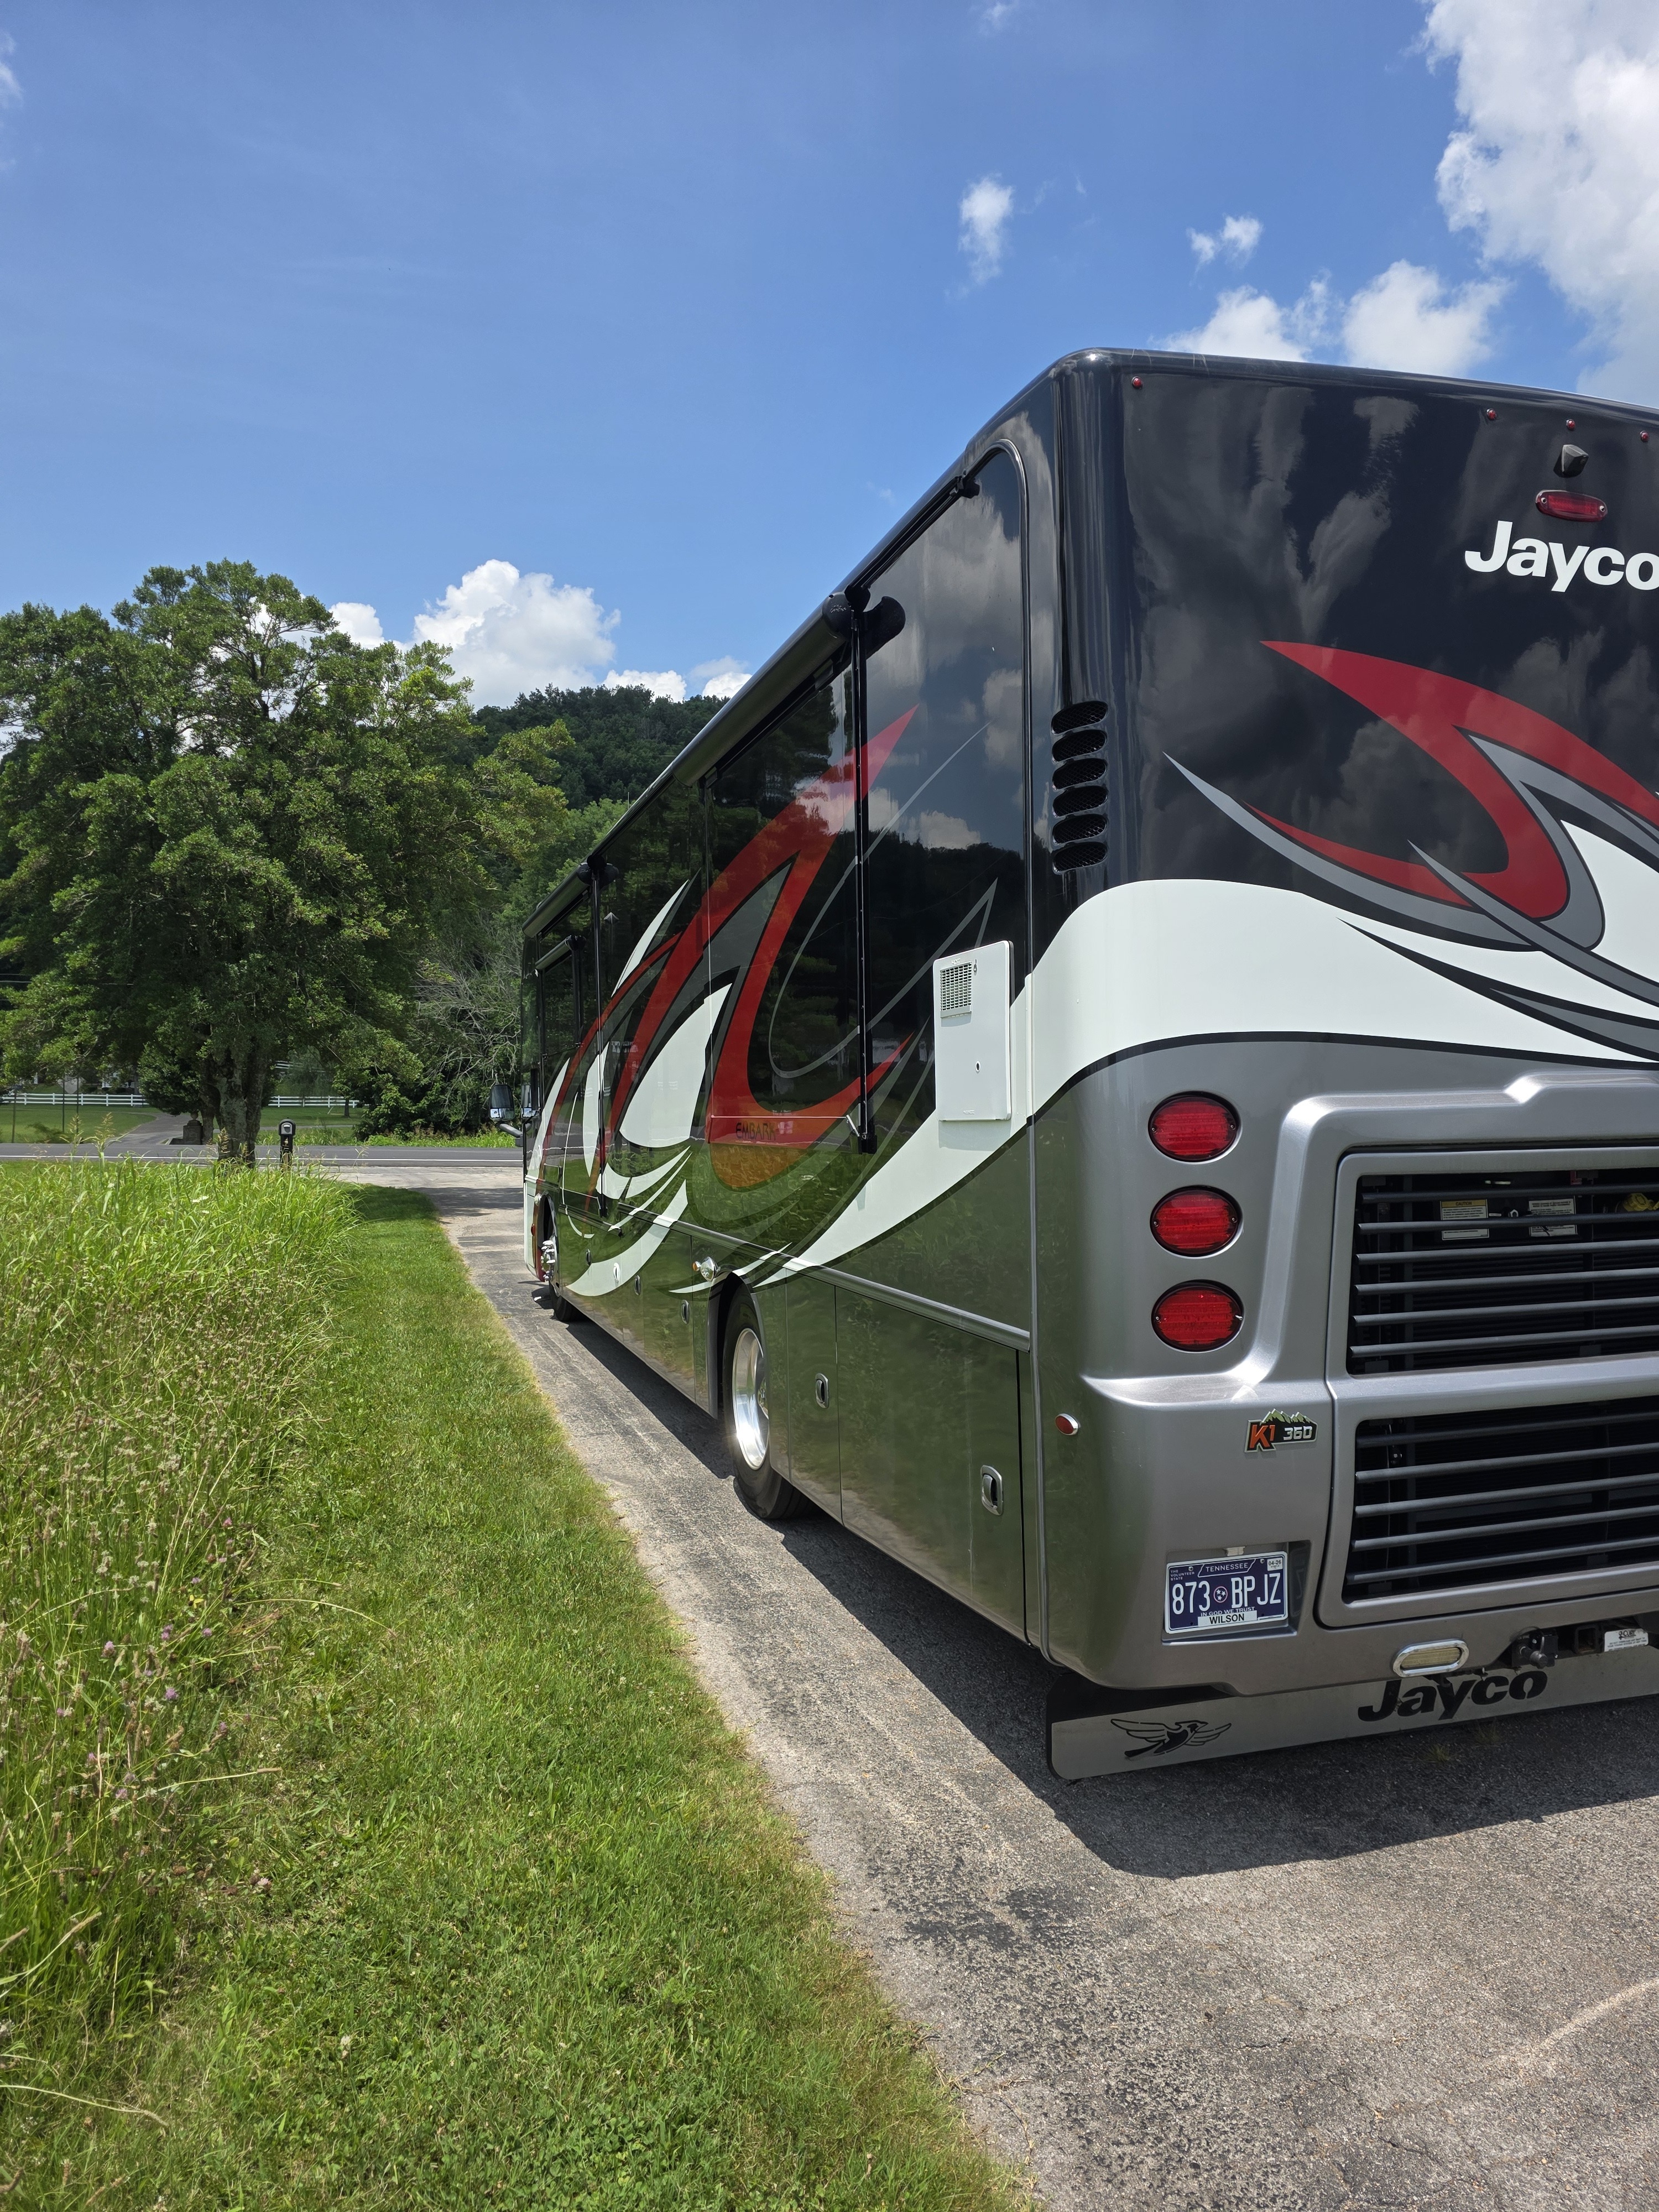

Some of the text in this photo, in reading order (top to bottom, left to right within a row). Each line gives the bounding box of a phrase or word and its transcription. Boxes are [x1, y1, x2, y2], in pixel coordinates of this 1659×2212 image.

[1464, 520, 1659, 592] Jayco
[735, 1121, 776, 1140] EMBARK
[1250, 1425, 1313, 1448] K1 360
[1206, 1562, 1249, 1573] TENNESSEE
[1172, 1580, 1211, 1615] 873
[1209, 1613, 1245, 1625] WILSON
[1358, 1670, 1548, 1722] Jayco
